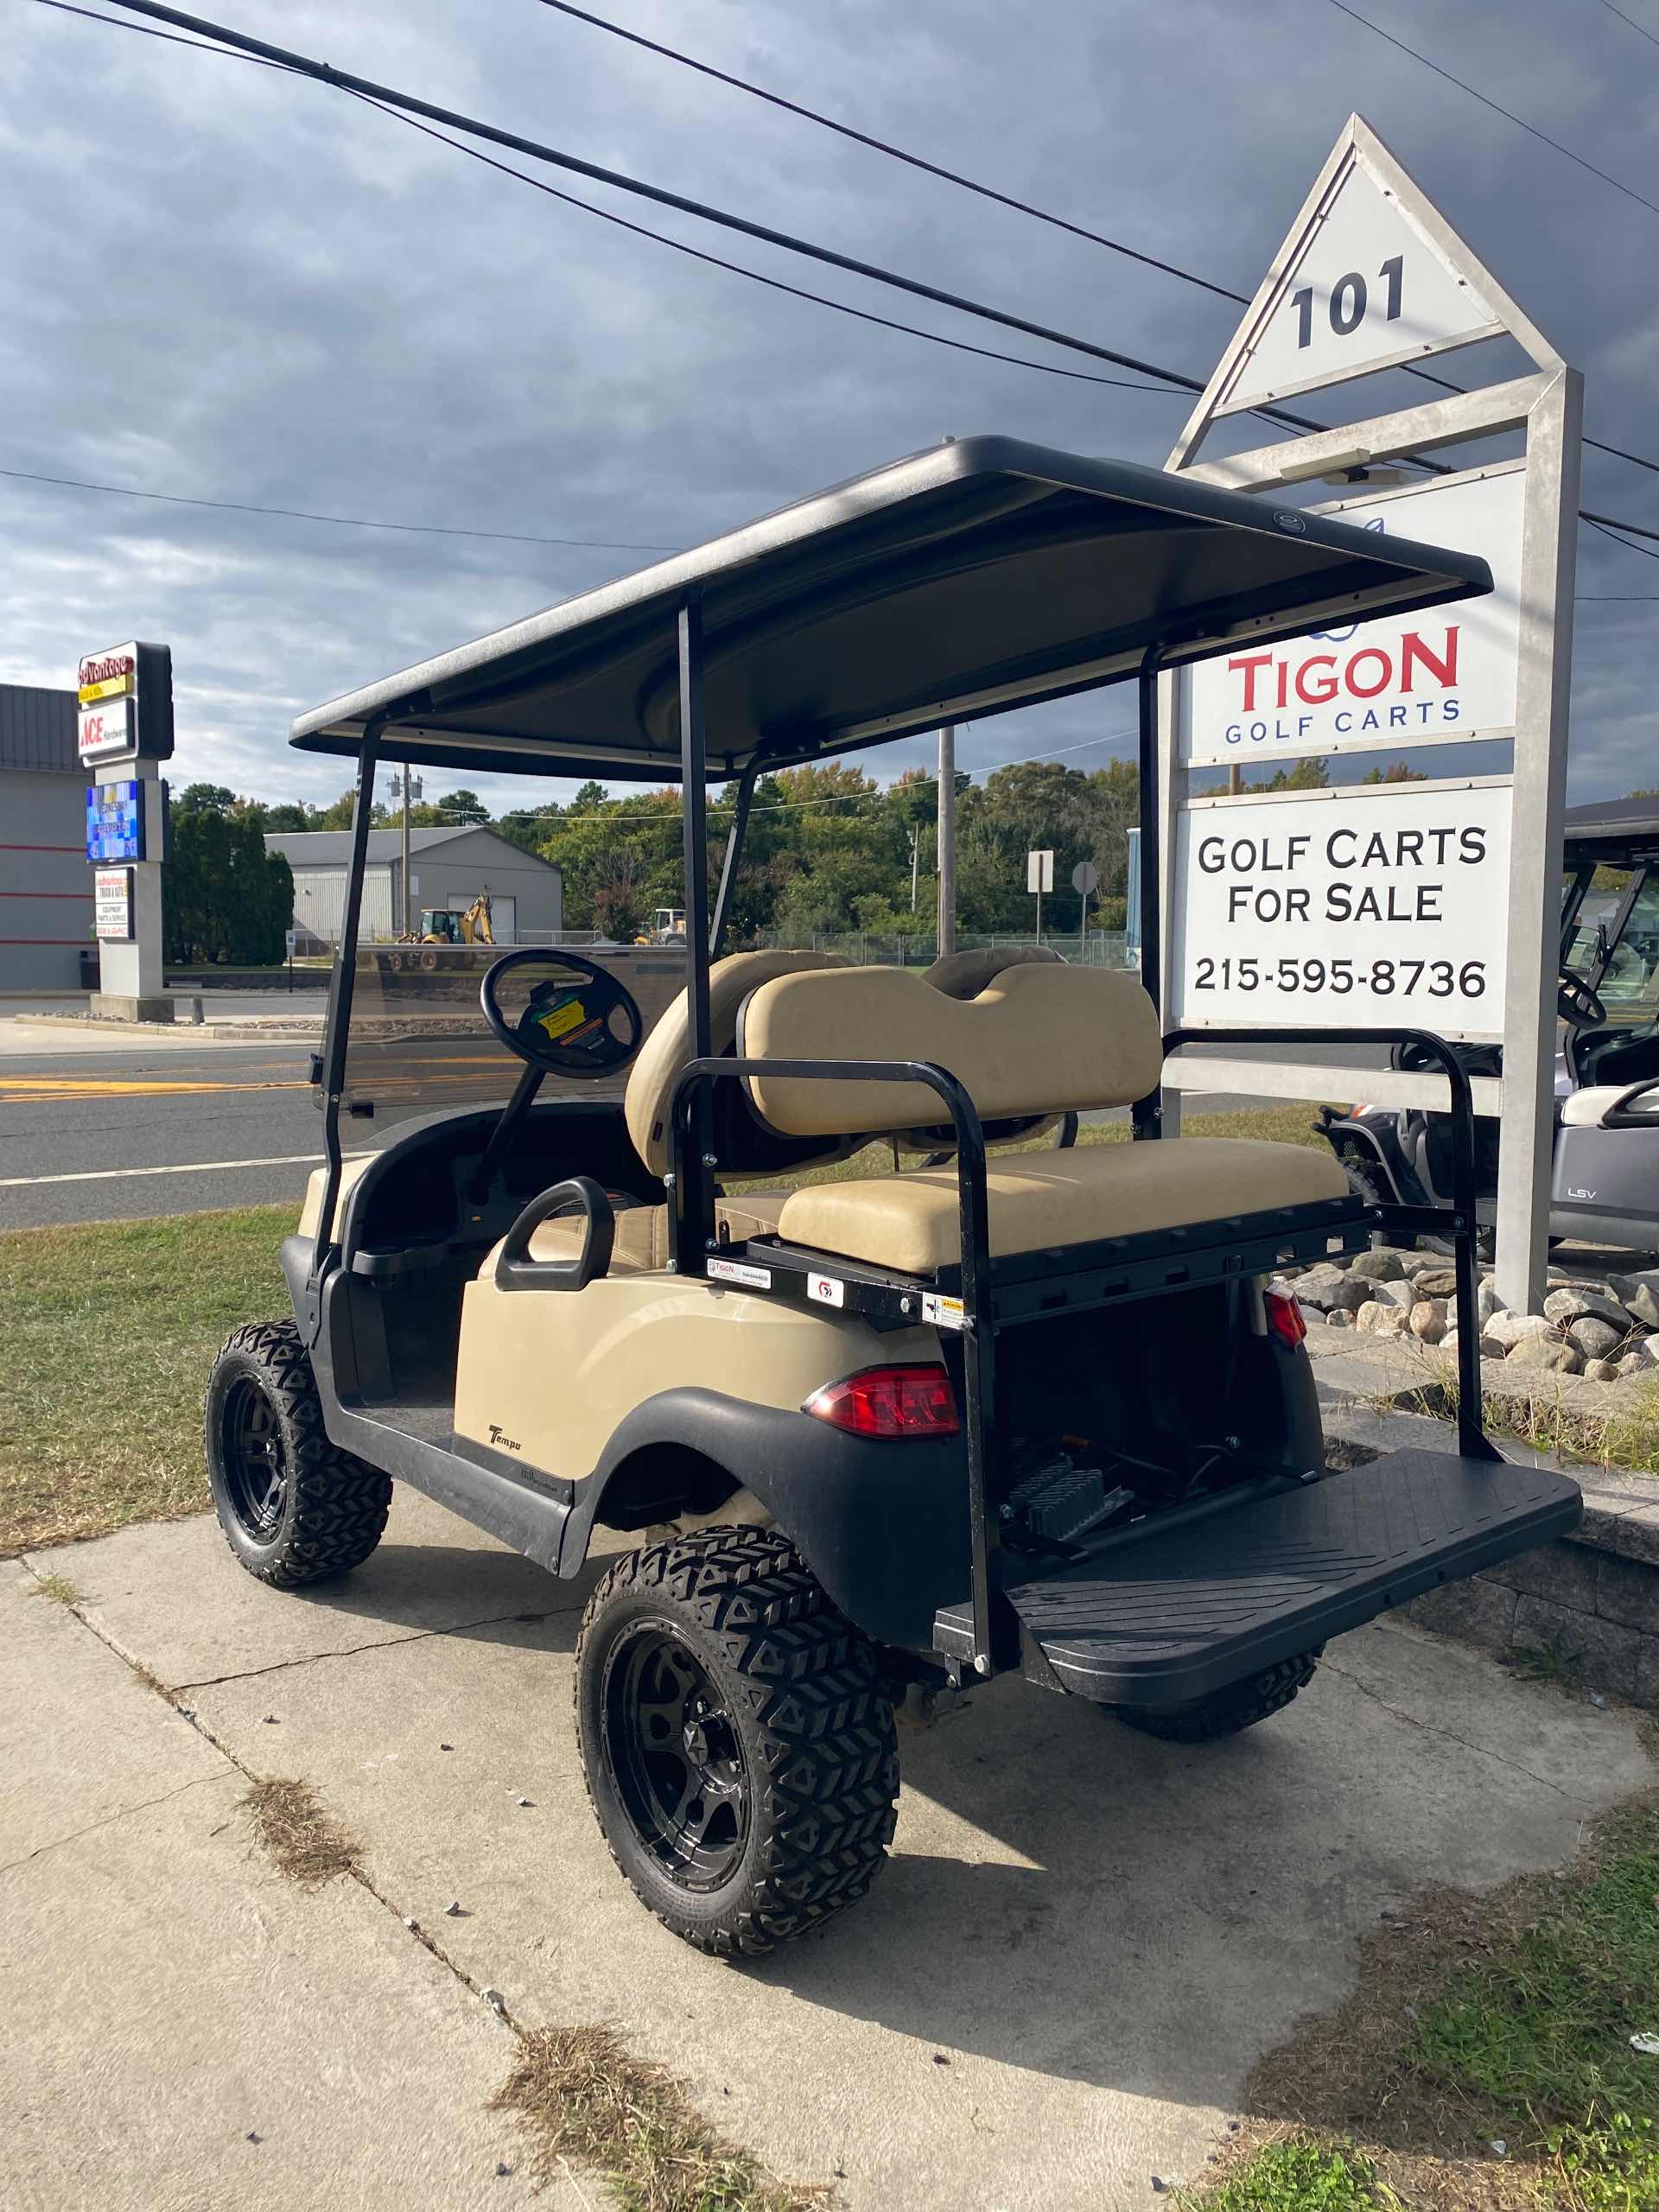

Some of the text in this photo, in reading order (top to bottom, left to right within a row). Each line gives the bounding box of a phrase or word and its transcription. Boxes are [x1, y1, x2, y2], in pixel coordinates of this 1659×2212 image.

[1290, 255, 1404, 350] 101
[1228, 626, 1460, 713] TIGON
[80, 717, 104, 747] ACE
[1225, 699, 1460, 745] GOLF CARTS
[1198, 826, 1487, 874] GOLF CARTS
[1227, 882, 1443, 923] FOR SALE
[1195, 957, 1487, 998] 215-595-8736
[1567, 1187, 1597, 1199] LSV
[715, 1262, 734, 1273] TIGON
[489, 1424, 522, 1451] Tempo
